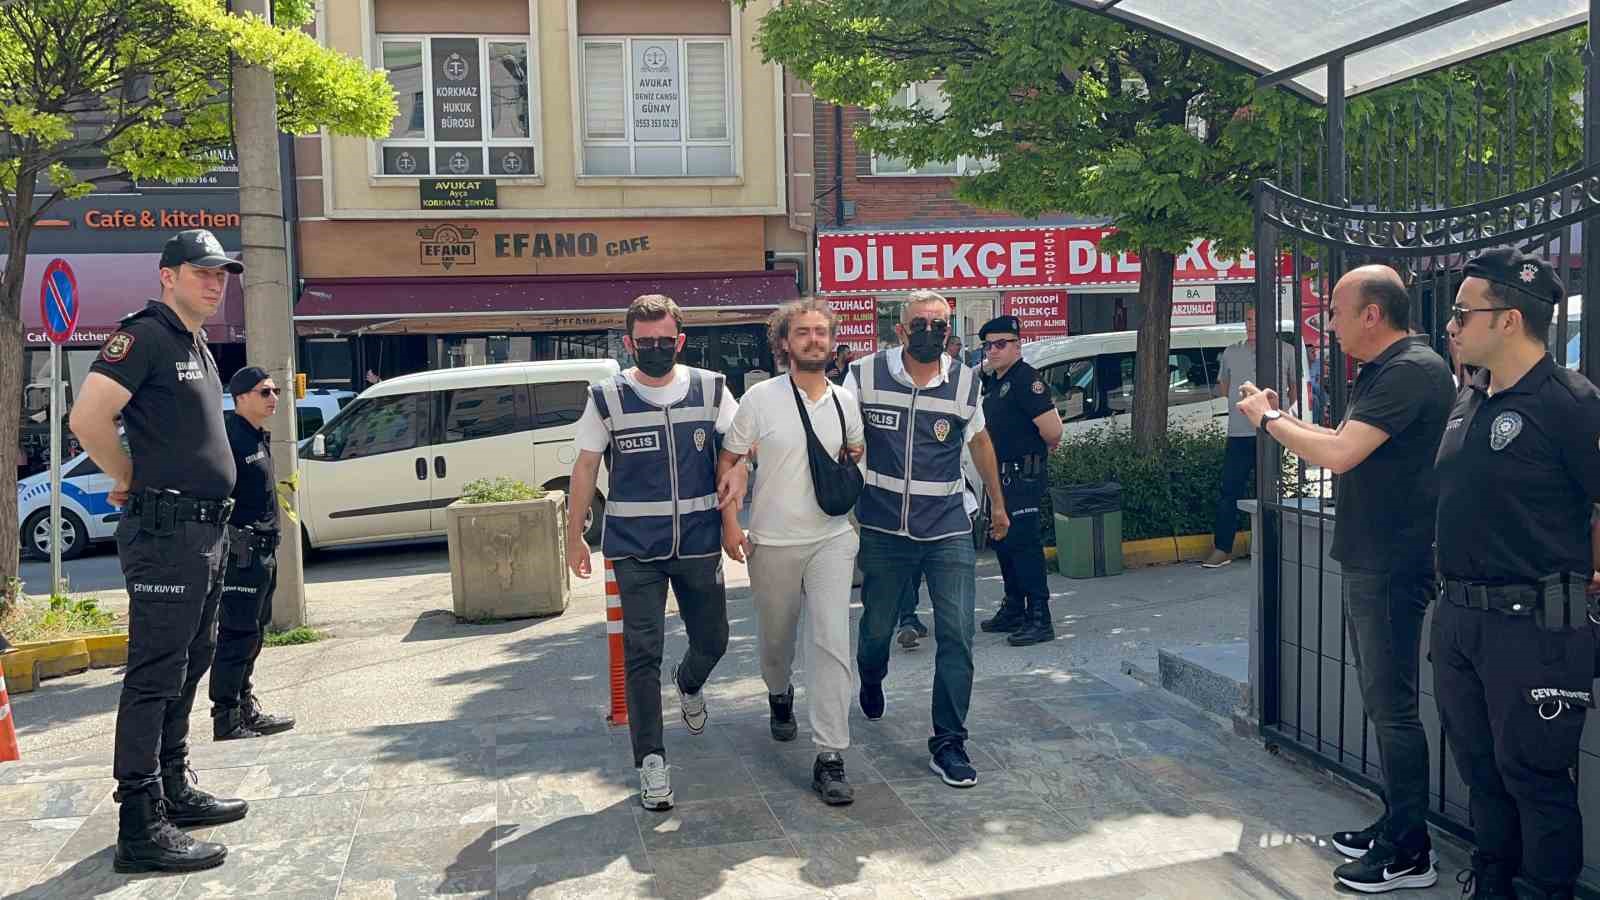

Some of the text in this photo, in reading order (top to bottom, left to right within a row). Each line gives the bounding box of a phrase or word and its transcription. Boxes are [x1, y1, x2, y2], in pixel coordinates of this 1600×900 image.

[640, 78, 673, 88] AVUKAT
[436, 86, 479, 97] KORKMAZ
[442, 102, 473, 113] HUKUK
[641, 102, 671, 113] GÜNAY
[441, 115, 475, 128] BÜROSU
[434, 181, 482, 190] AVUKAT
[423, 199, 461, 207] KORKMAZ
[84, 208, 240, 228] Cafe & kitchen
[424, 244, 471, 257] EFANO
[494, 232, 651, 258] EFANO CAFE
[833, 238, 1037, 285] DİLEKÇE
[1010, 293, 1059, 305] FOTOKOPİ
[1186, 289, 1201, 298] 8A
[1011, 307, 1058, 317] DİLEKÇE
